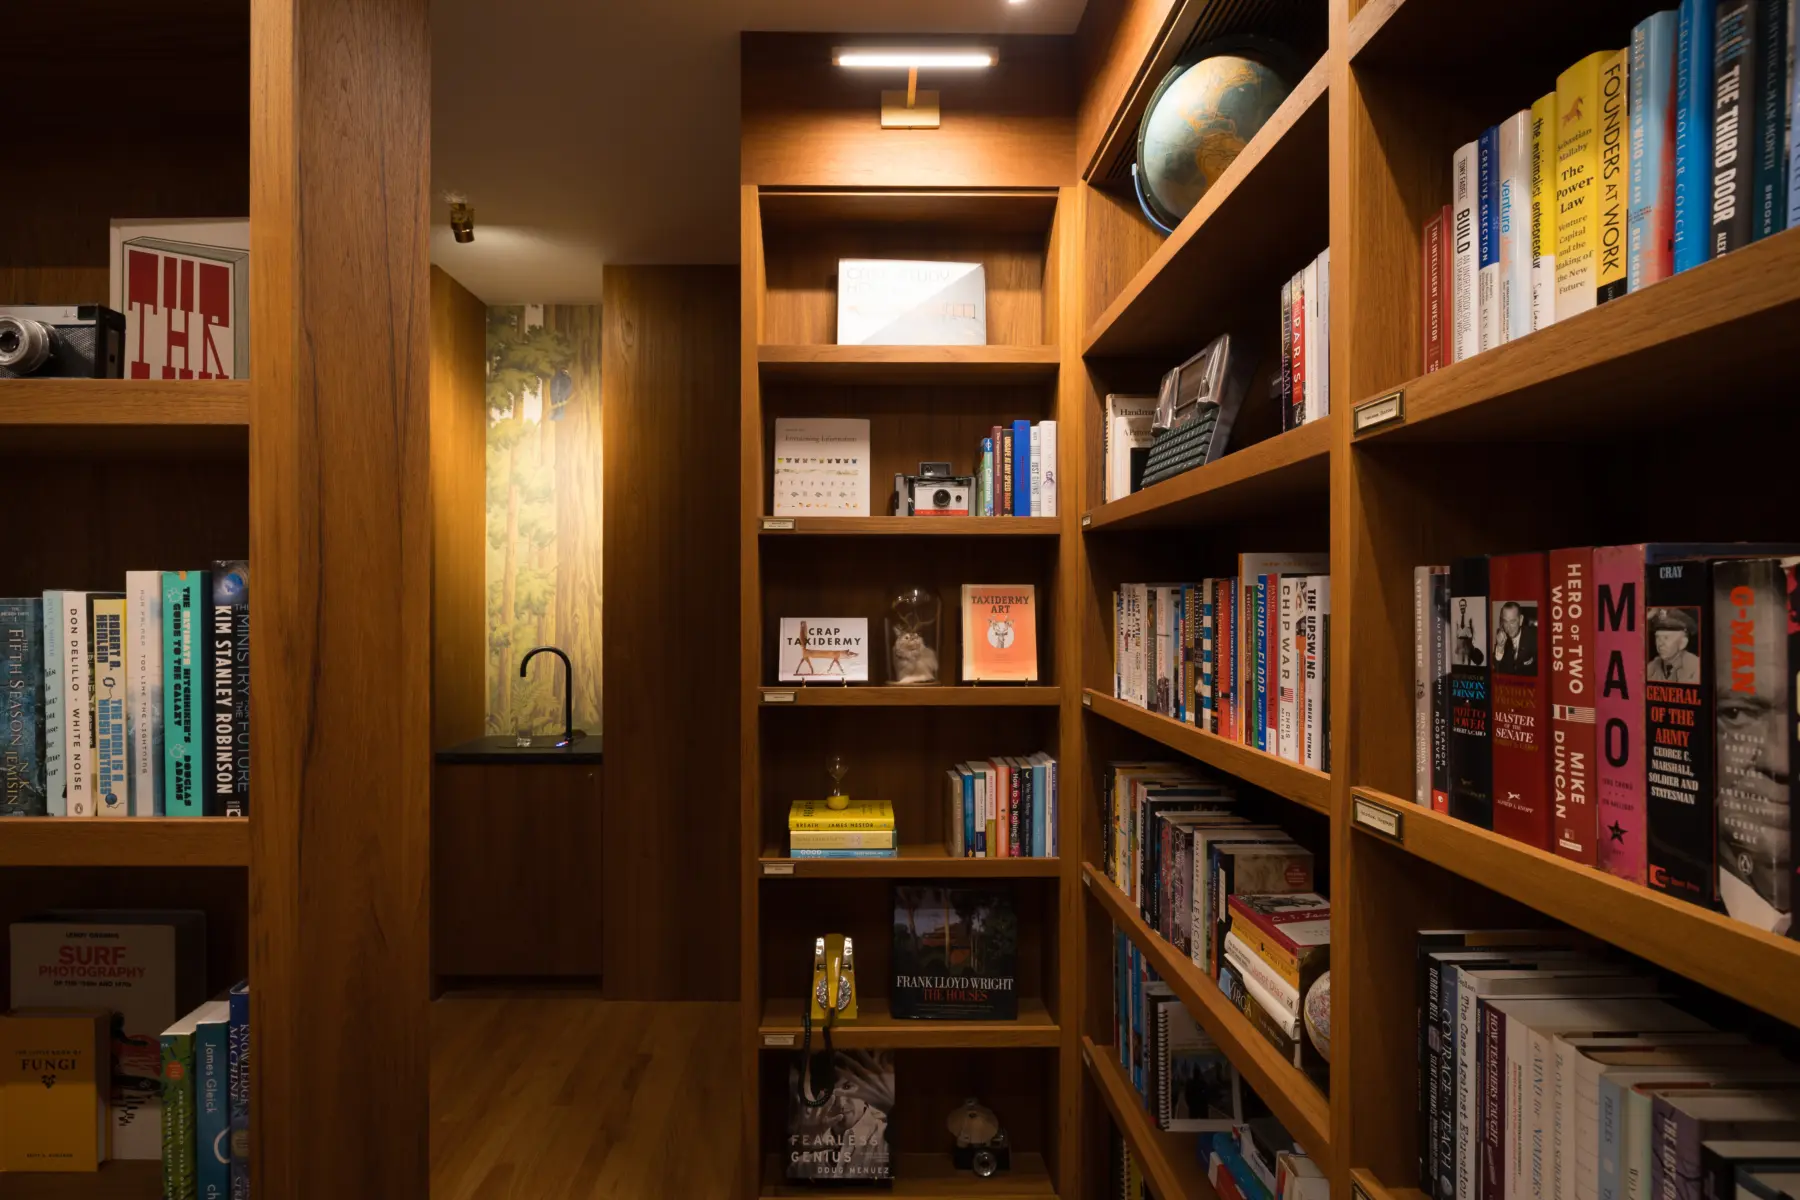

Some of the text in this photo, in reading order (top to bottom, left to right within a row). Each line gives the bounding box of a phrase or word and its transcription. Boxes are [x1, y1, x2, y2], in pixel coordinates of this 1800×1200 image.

[1556, 127, 1592, 153] Sebastian
[1559, 141, 1589, 162] Mallaby
[1633, 125, 1644, 160] WHO
[1674, 20, 1691, 243] TRILLION DOLLAR COACH
[1713, 65, 1741, 226] THE THIRD DOOR
[1458, 159, 1468, 201] TONY FADELL
[1481, 149, 1490, 201] CREATIVE
[1531, 118, 1545, 269] the minimalist entrepreneur
[1556, 176, 1595, 201] Power
[1561, 164, 1584, 182] The
[1602, 63, 1622, 276] FOUNDERS AT WORK
[1500, 178, 1512, 234] venture
[1558, 213, 1588, 233] Venture
[1559, 195, 1585, 215] Law
[1764, 184, 1773, 235] BROOKS
[1431, 224, 1439, 242] THE
[1456, 208, 1471, 254] BUILD
[1481, 204, 1490, 262] SELECTION
[1558, 240, 1587, 258] and the
[1559, 225, 1587, 245] Capital
[1716, 231, 1727, 251] ALEX
[1431, 243, 1439, 298] INTELLIGENT
[1556, 249, 1593, 271] Making of
[1556, 266, 1588, 284] the New
[1462, 264, 1472, 333] UNORTHODOX GUIDE
[1558, 279, 1586, 296] Future
[1293, 316, 1302, 383] PARIS
[1004, 436, 1012, 492] UNSAFE SPEED
[970, 595, 1030, 605] TAXIDERMY
[990, 604, 1011, 614] ART
[1415, 578, 1423, 641] NOTORIOUS
[9, 629, 25, 673] FIFTH
[70, 608, 80, 691] DON DELILLO
[96, 614, 109, 664] HEINLEIN
[109, 614, 121, 657] ROBERT
[786, 637, 862, 646] TAXIDERMY
[808, 627, 841, 636] CRAP
[1257, 583, 1265, 693] RAISING FLOOR
[1281, 585, 1291, 680] CHIP WAR
[1306, 588, 1317, 680] THE UPSWING
[1551, 585, 1564, 672] WORLDS
[1567, 563, 1584, 695] HERO OF TWO
[1730, 584, 1757, 696] G-MAN
[173, 603, 182, 727] GUIDE TO THE GALAXY
[183, 587, 192, 744] THE ULTIMATE HITCHHIKER'S
[237, 614, 249, 696] MINISTRY
[1598, 582, 1636, 768] MAO
[9, 680, 25, 746] SEASON
[215, 605, 233, 794] KIM STANLEY ROBINSON
[1494, 711, 1535, 728] MASTER
[1646, 685, 1702, 706] GENERAL
[1650, 706, 1696, 727] OF THE
[72, 708, 82, 791] WHITE NOISE
[98, 700, 112, 795] HARSH MISTRESS
[110, 699, 124, 770] THE MOON IS
[237, 721, 249, 793] FUTURE
[1495, 727, 1534, 744] SENATE
[1653, 746, 1693, 763] GEORGE C.
[1655, 727, 1691, 748] ARMY
[5, 751, 19, 805] JEMISIN
[175, 761, 184, 800] ADAMS
[184, 755, 192, 807] DOUGLAS
[1554, 730, 1567, 819] DUNCAN
[1569, 751, 1586, 805] MIKE
[1648, 771, 1699, 792] SOLDIER AND
[1651, 759, 1695, 777] MARSHALL,
[1010, 773, 1019, 837] How to Do Nothing
[1651, 786, 1696, 805] STATESMAN
[1719, 787, 1772, 804] AMERICAN
[1722, 799, 1769, 817] CENTURY
[1193, 899, 1201, 962] LEXICON
[38, 965, 147, 979] PHOTOGRAPHY
[58, 945, 127, 966] SURF
[896, 975, 1014, 991] FRANK LLOYD WRIGHT
[923, 988, 989, 1003] THE HOUSES
[1429, 967, 1440, 1023] DERRICK BELL
[21, 1059, 76, 1071] FUNGI
[205, 1042, 218, 1114] James Gleick
[229, 1025, 239, 1101] MACHINE
[1429, 1054, 1439, 1079] SILENT
[1490, 1012, 1499, 1147] HOW TEACHERS TAUGHT
[1441, 1008, 1453, 1170] COURAGE TEACH
[1459, 995, 1470, 1199] The Case Against Education
[791, 1134, 879, 1146] FEARLESS
[1533, 1054, 1544, 1199] MIND NUMBERS
[790, 1151, 852, 1163] GENIUS
[817, 1166, 890, 1174] DOUG MENUEZ
[1663, 1145, 1677, 1182] LOST
